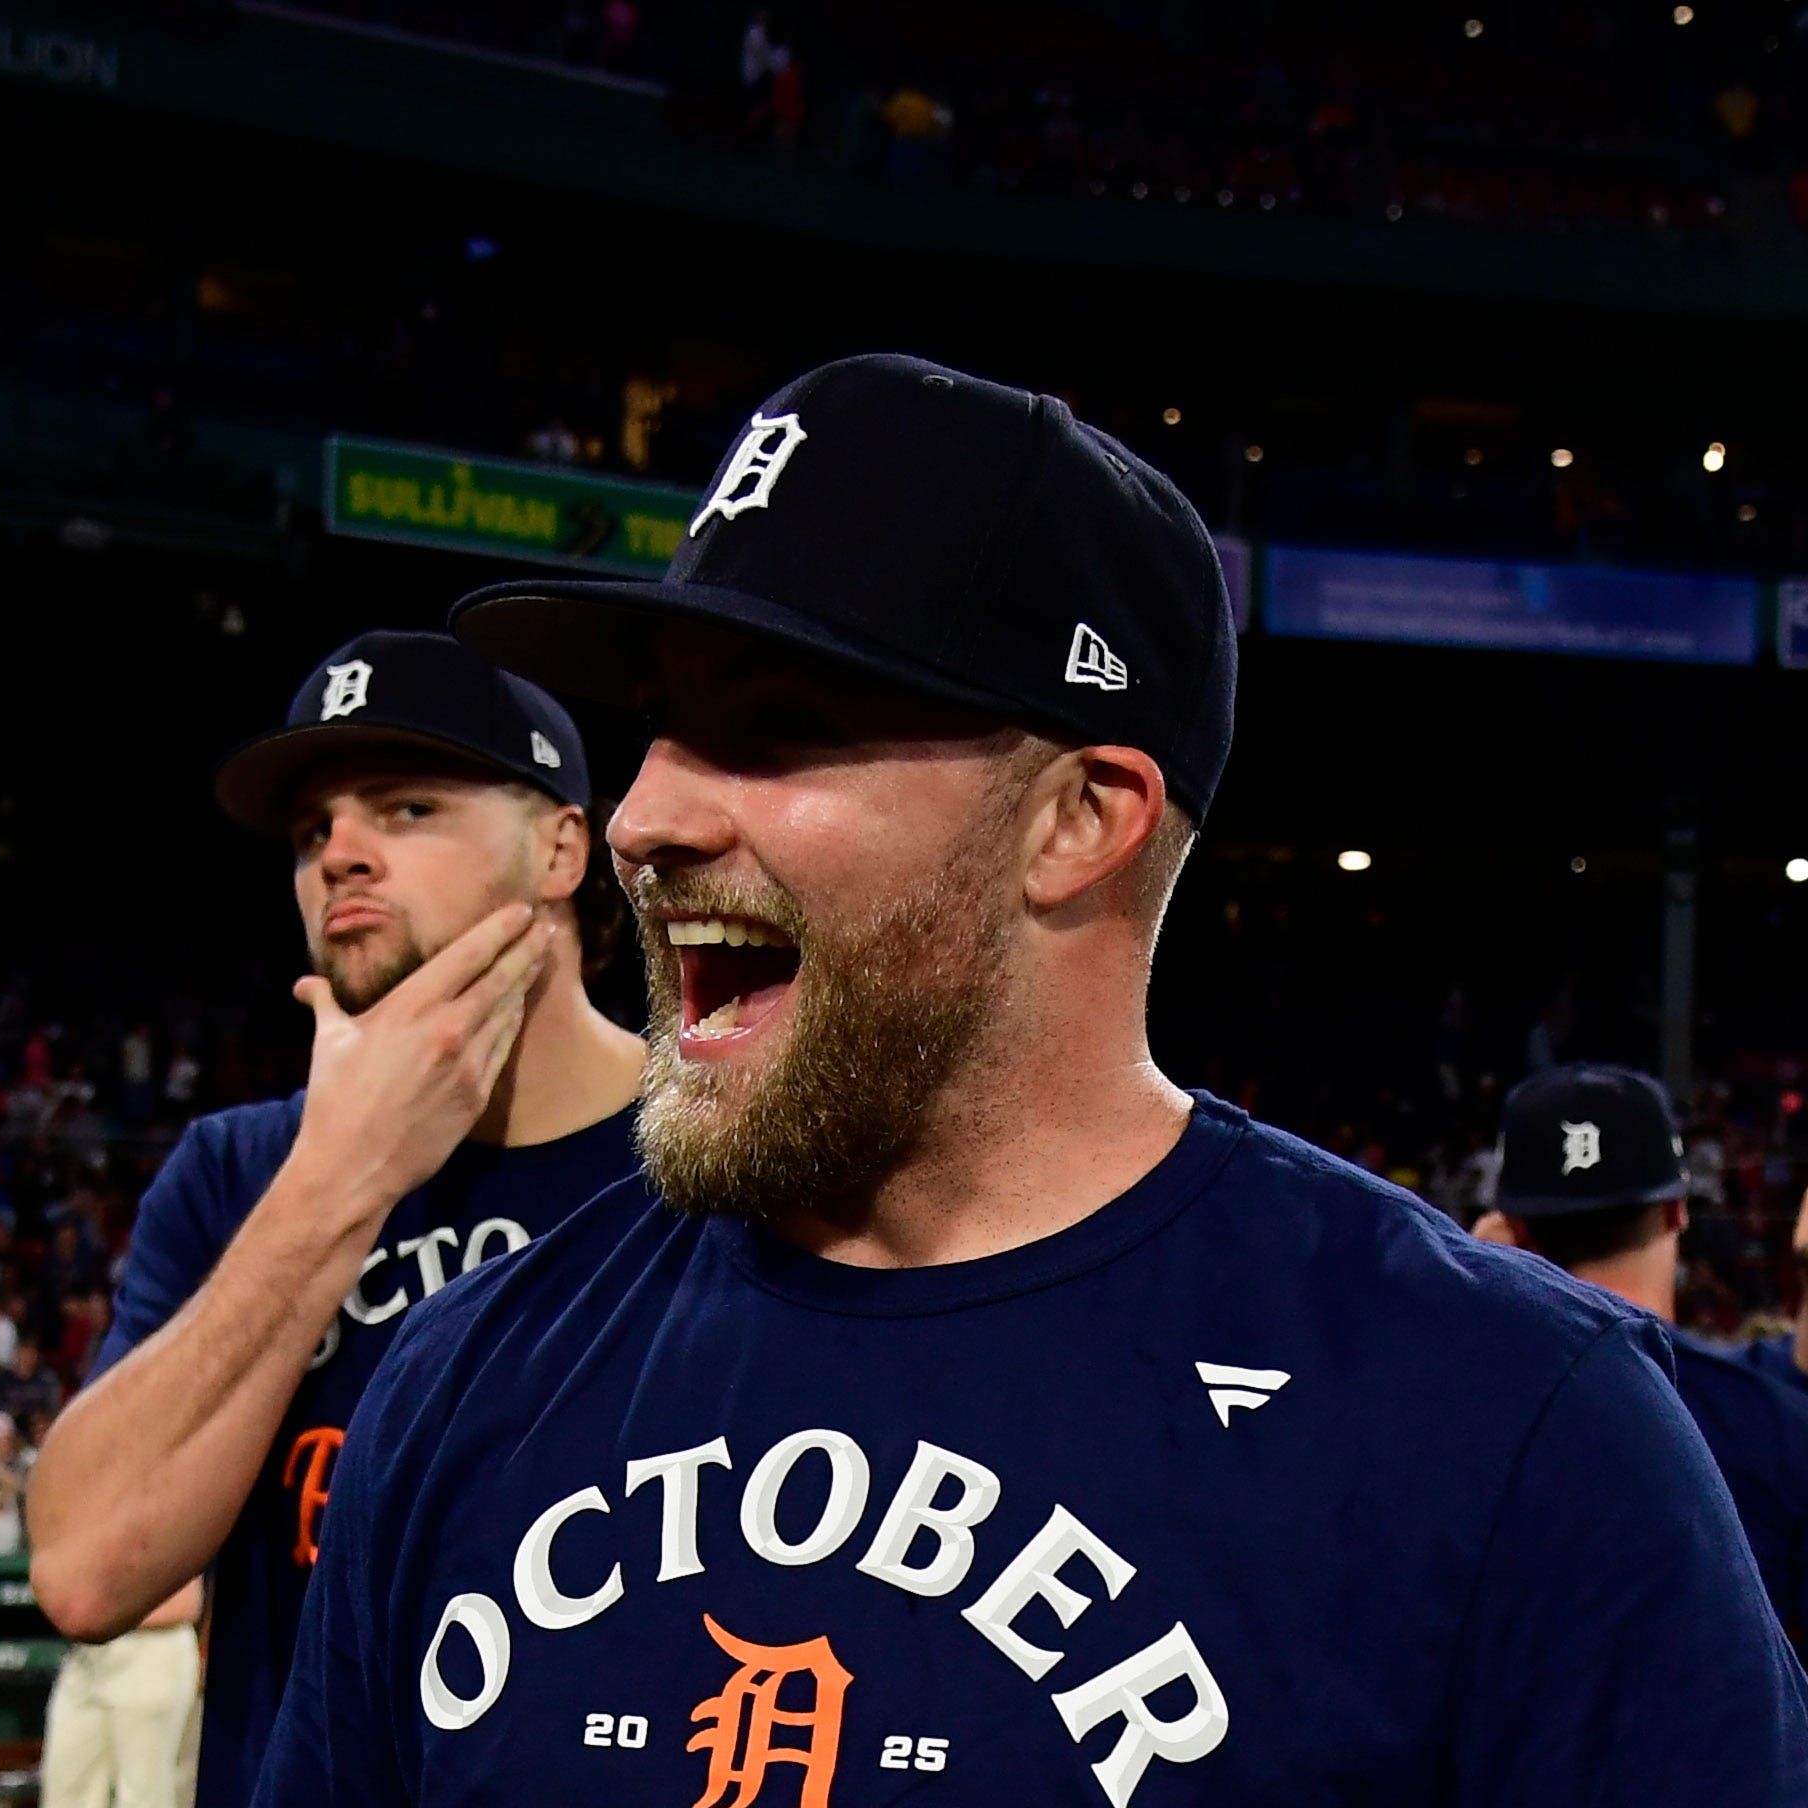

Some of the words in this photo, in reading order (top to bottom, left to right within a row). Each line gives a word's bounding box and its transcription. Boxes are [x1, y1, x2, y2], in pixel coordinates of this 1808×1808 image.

[345, 463, 559, 543] SULLIVAN
[583, 1711, 649, 1750] 20
[879, 1734, 949, 1772] 25
